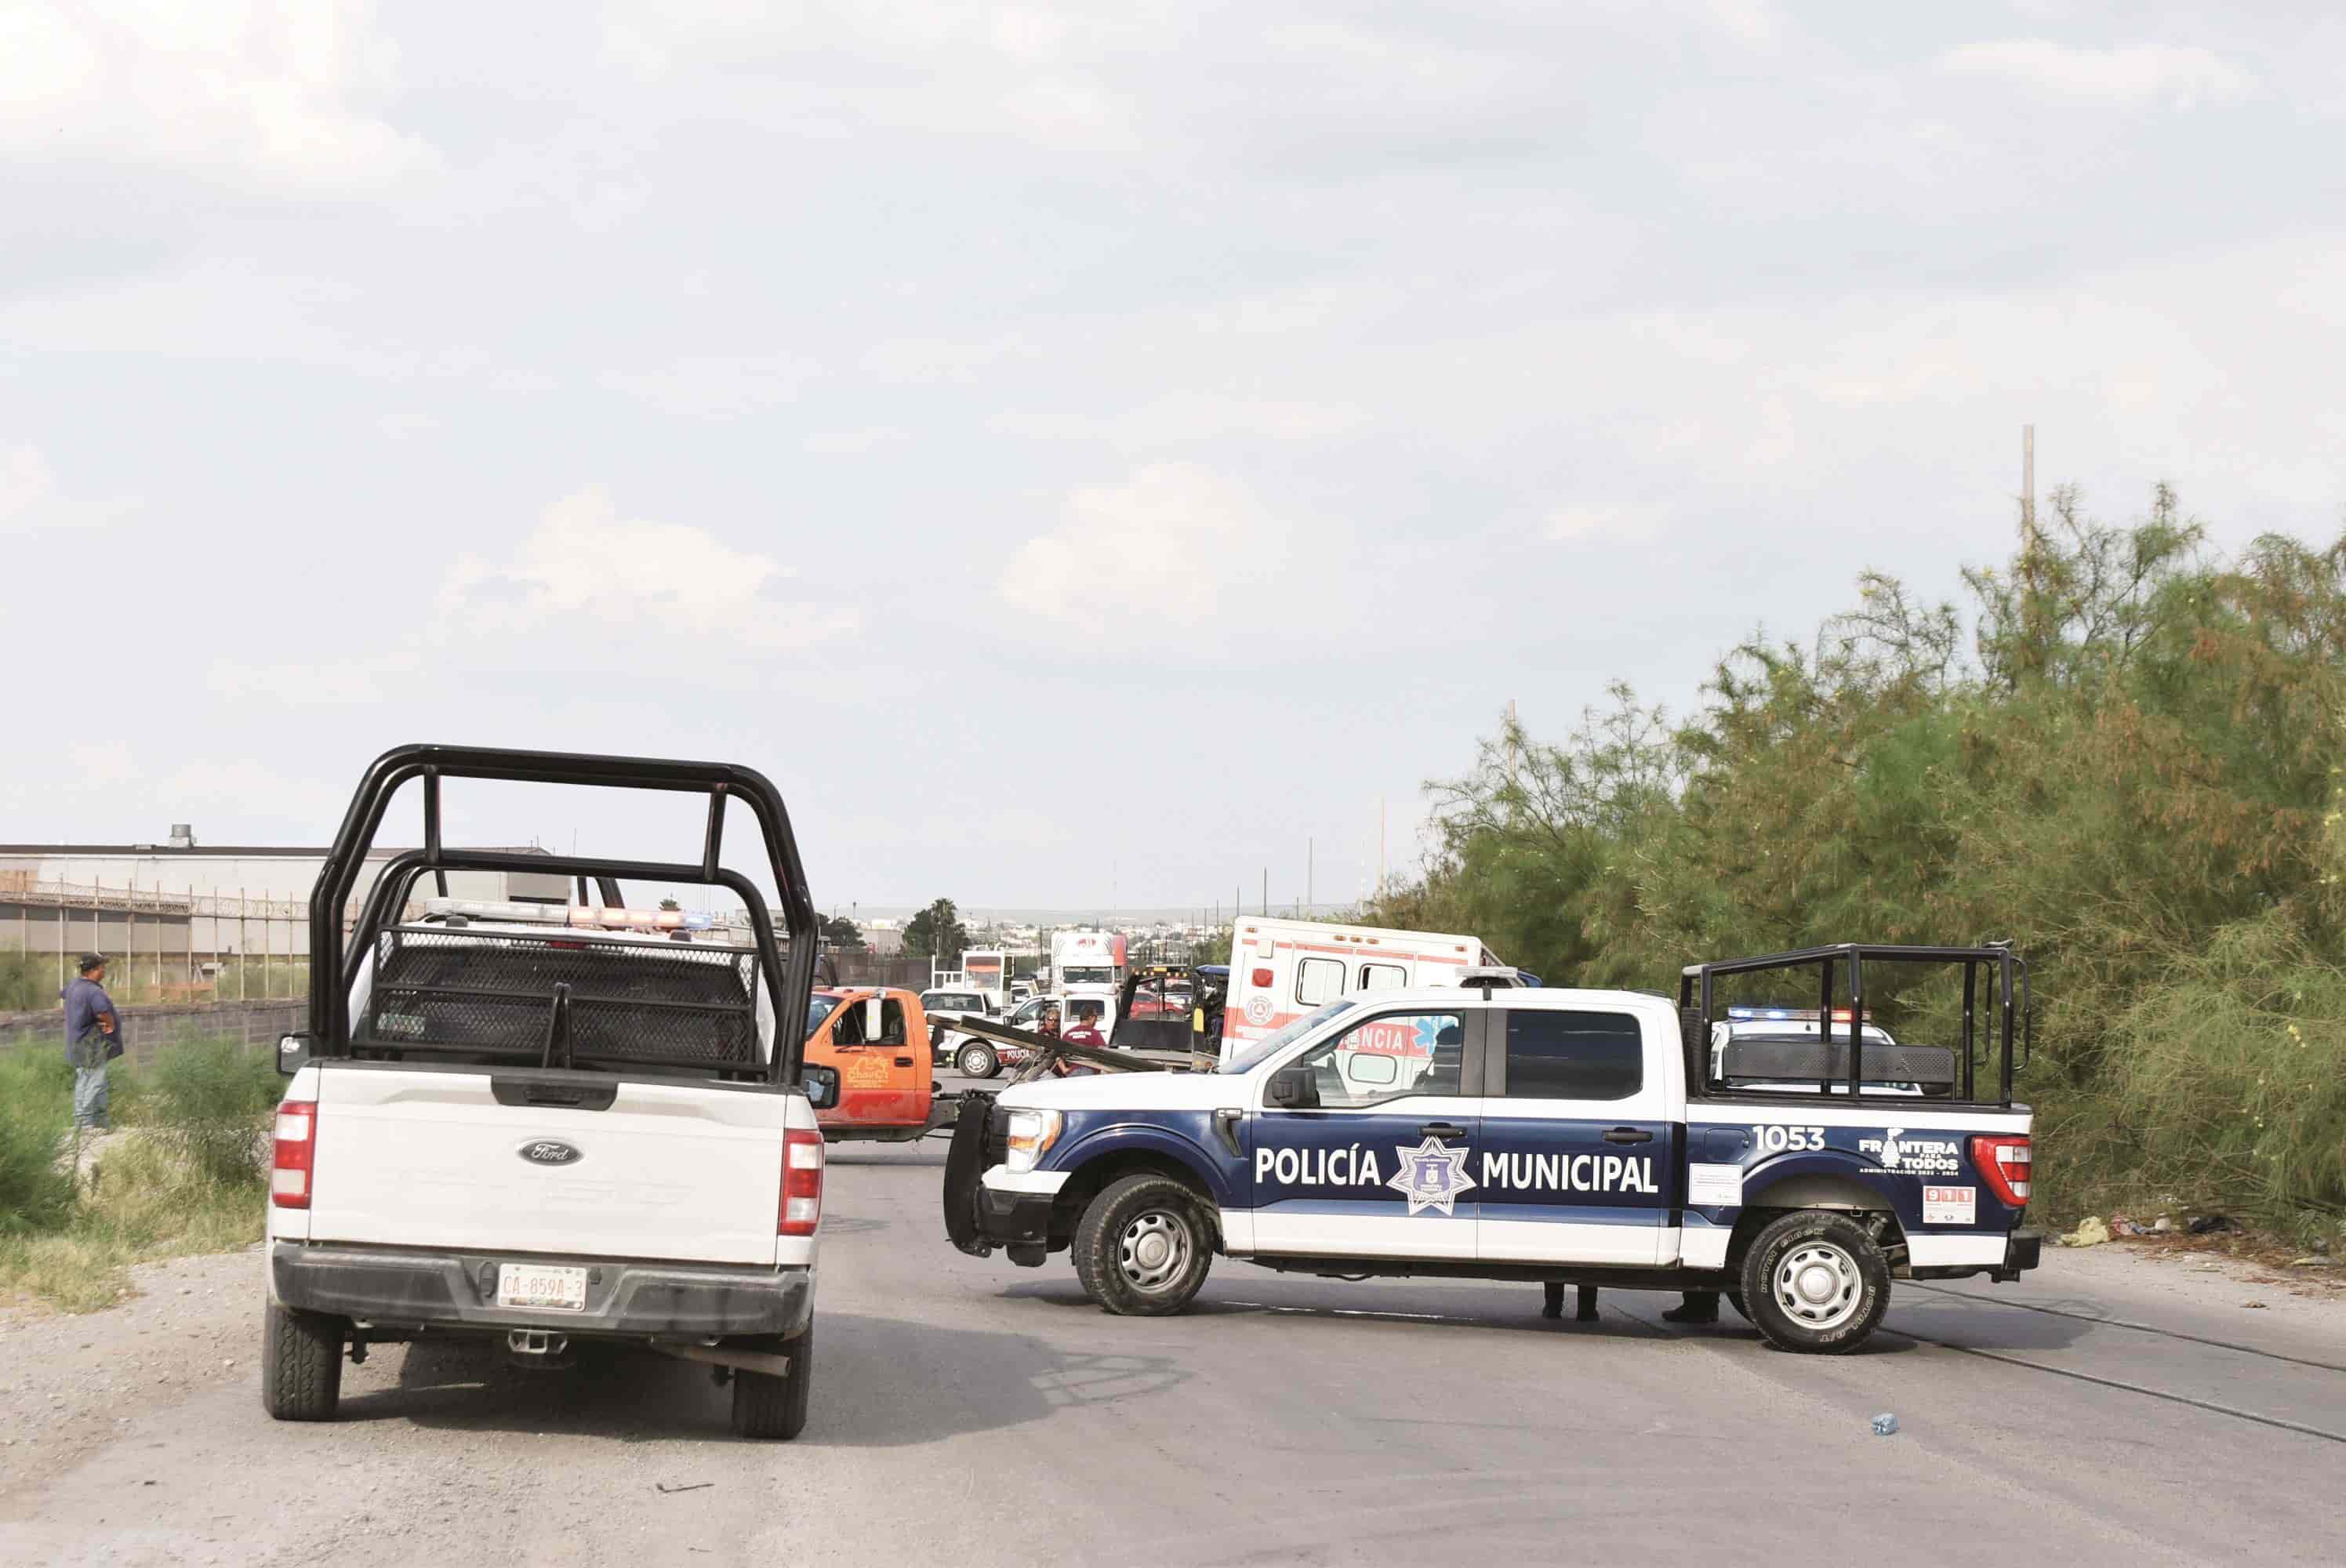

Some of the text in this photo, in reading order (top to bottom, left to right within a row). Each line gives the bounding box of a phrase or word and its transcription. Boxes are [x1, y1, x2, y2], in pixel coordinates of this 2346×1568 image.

[1752, 1125, 1825, 1151] 1053
[532, 1143, 568, 1160] Ford
[1858, 1139, 1959, 1155] FRNTERA
[1255, 1143, 1658, 1193] POLICÍA MUNICIPAL
[1901, 1157, 1959, 1171] TODOS
[1928, 1189, 1970, 1202] 911
